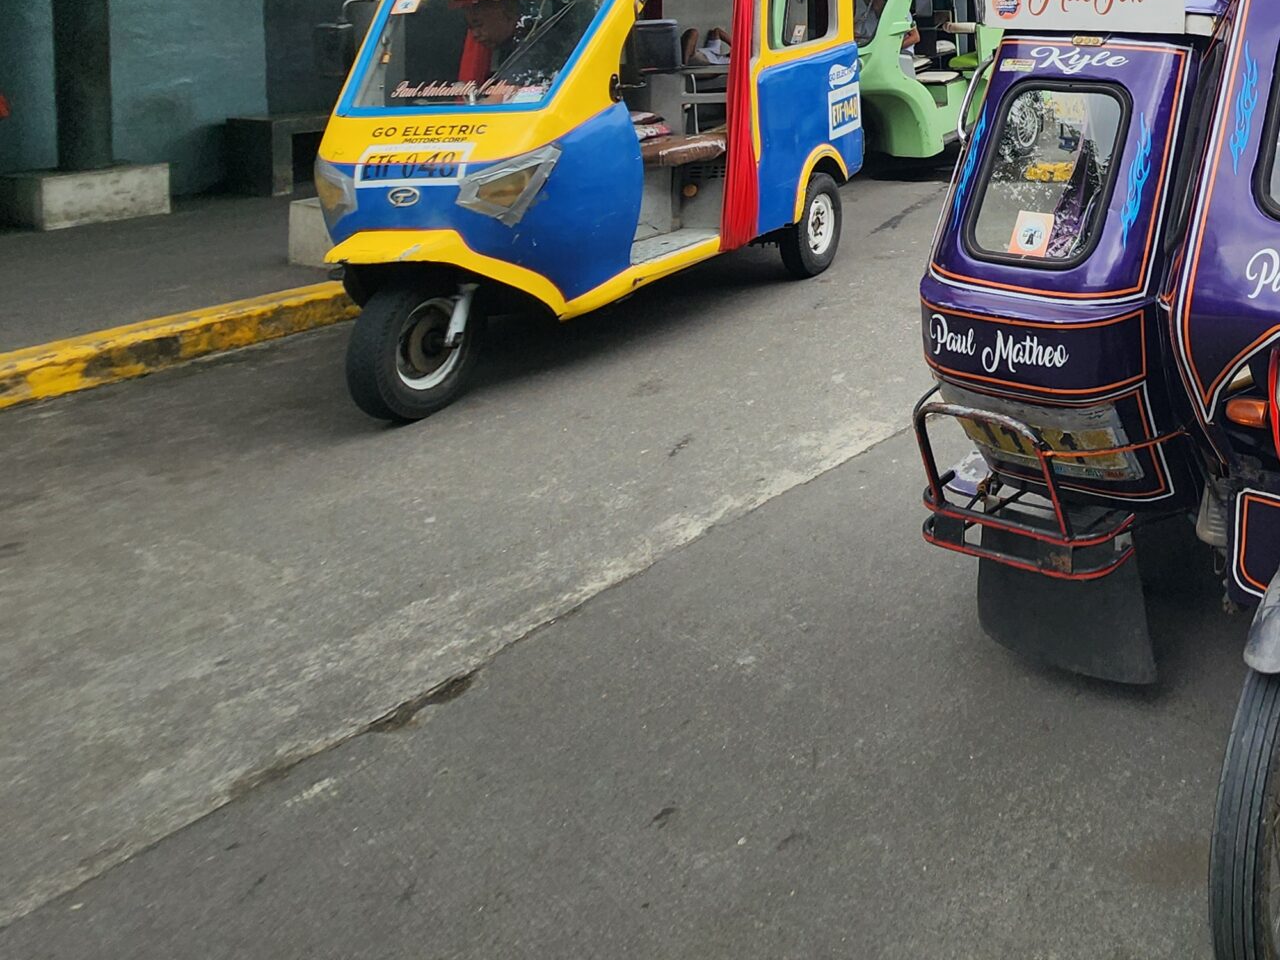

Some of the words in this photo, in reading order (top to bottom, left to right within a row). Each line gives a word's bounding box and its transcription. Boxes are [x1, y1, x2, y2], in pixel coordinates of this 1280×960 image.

[1030, 46, 1129, 75] Kyle
[390, 81, 424, 98] Paul
[372, 127, 398, 138] GO
[402, 124, 488, 137] ELECTRIC
[929, 313, 977, 355] Paul
[981, 329, 1069, 374] Matheo
